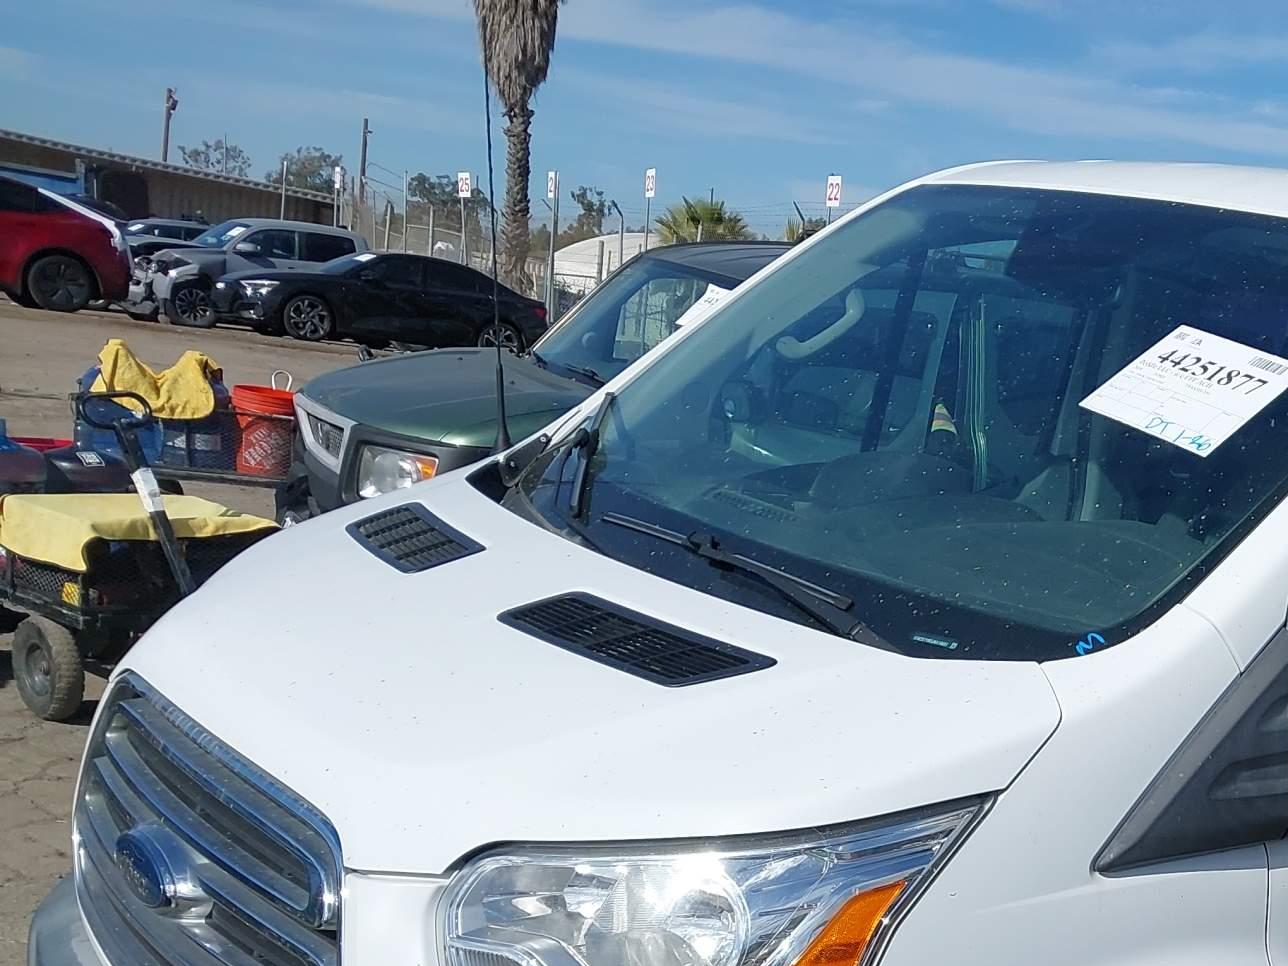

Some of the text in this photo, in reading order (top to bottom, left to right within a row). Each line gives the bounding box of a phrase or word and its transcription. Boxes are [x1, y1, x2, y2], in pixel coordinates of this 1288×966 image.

[459, 177, 470, 193] 25
[646, 175, 655, 193] 23
[828, 182, 840, 201] 22
[1158, 349, 1269, 395] 44251877
